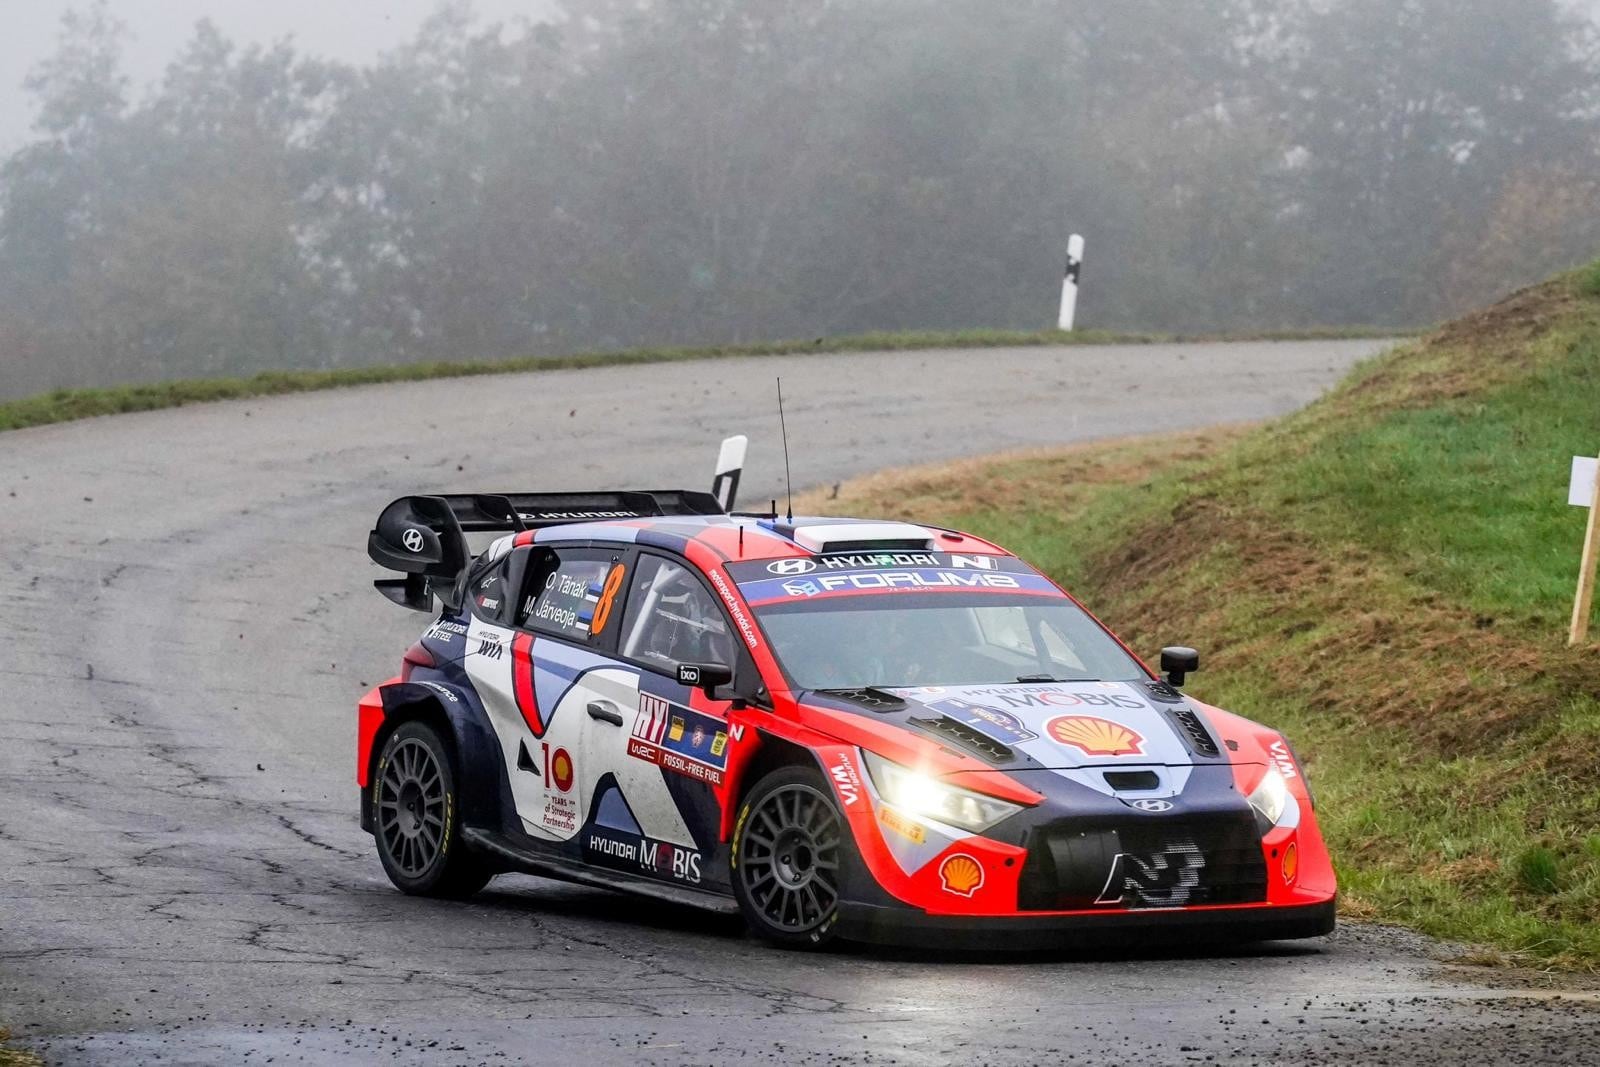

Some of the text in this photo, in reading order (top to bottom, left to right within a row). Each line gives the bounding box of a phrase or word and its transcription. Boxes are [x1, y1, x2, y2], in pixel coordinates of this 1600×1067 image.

[822, 553, 939, 569] HYUNDAI
[545, 571, 587, 598] O. Tänak
[819, 572, 1020, 591] FORUM8
[592, 564, 625, 634] 8
[710, 569, 757, 648] motorsport.hyundai.com
[523, 595, 536, 615] M.
[536, 599, 576, 629] Järveoja
[433, 630, 452, 642] STEEL
[963, 687, 1064, 696] HYUNDAI
[997, 692, 1145, 709] MOBIS
[663, 753, 721, 784] FOSSIL-FREE FUEL
[551, 796, 568, 807] YEARS
[544, 804, 576, 820] of Strategic
[543, 814, 576, 831] Partnership
[590, 835, 637, 860] HYUNDAI
[640, 839, 702, 884] MOBIS
